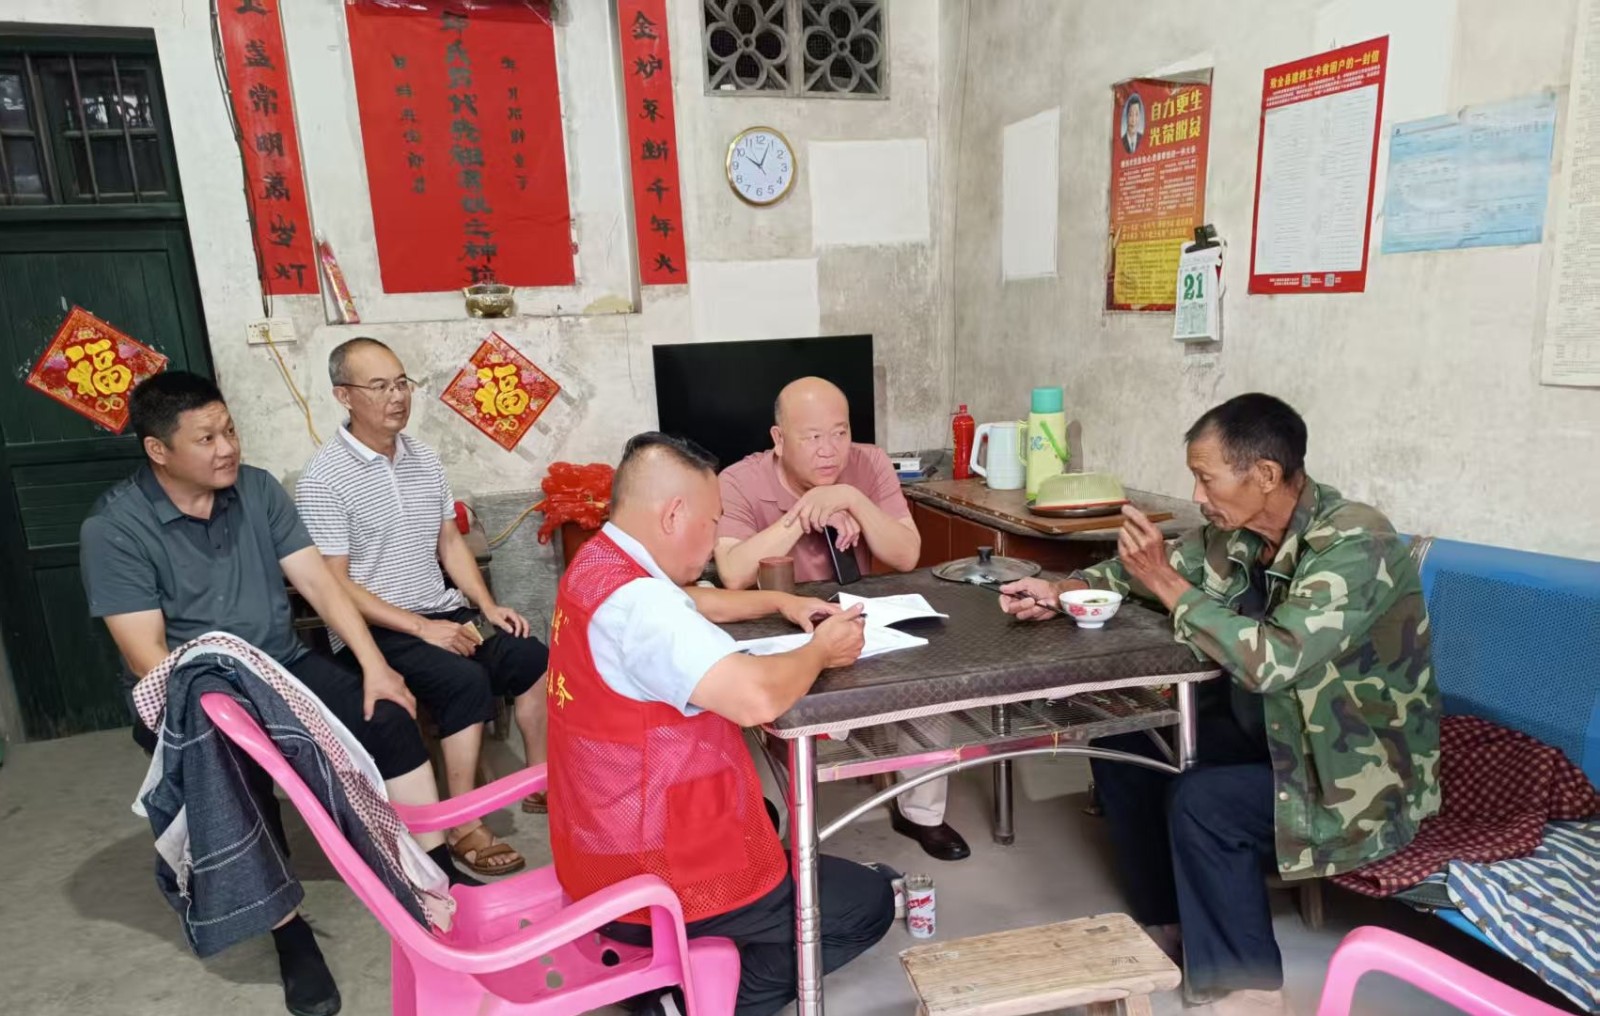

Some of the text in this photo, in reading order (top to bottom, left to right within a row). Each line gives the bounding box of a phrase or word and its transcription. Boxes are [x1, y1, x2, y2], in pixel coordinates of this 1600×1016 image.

[1151, 89, 1203, 121] 自力更生
[1149, 116, 1202, 148] 光荣脱贫
[745, 138, 752, 148] 11
[756, 135, 766, 145] 12
[736, 147, 746, 157] 10
[777, 149, 784, 159] 2
[732, 161, 739, 170] 9
[781, 163, 788, 172] 3
[736, 175, 743, 184] 8
[776, 176, 782, 185] 4
[744, 184, 752, 193] 7
[756, 188, 763, 196] 6
[767, 185, 775, 194] 5
[1183, 272, 1204, 301] 21
[64, 338, 133, 397] 福
[474, 363, 530, 418] 福
